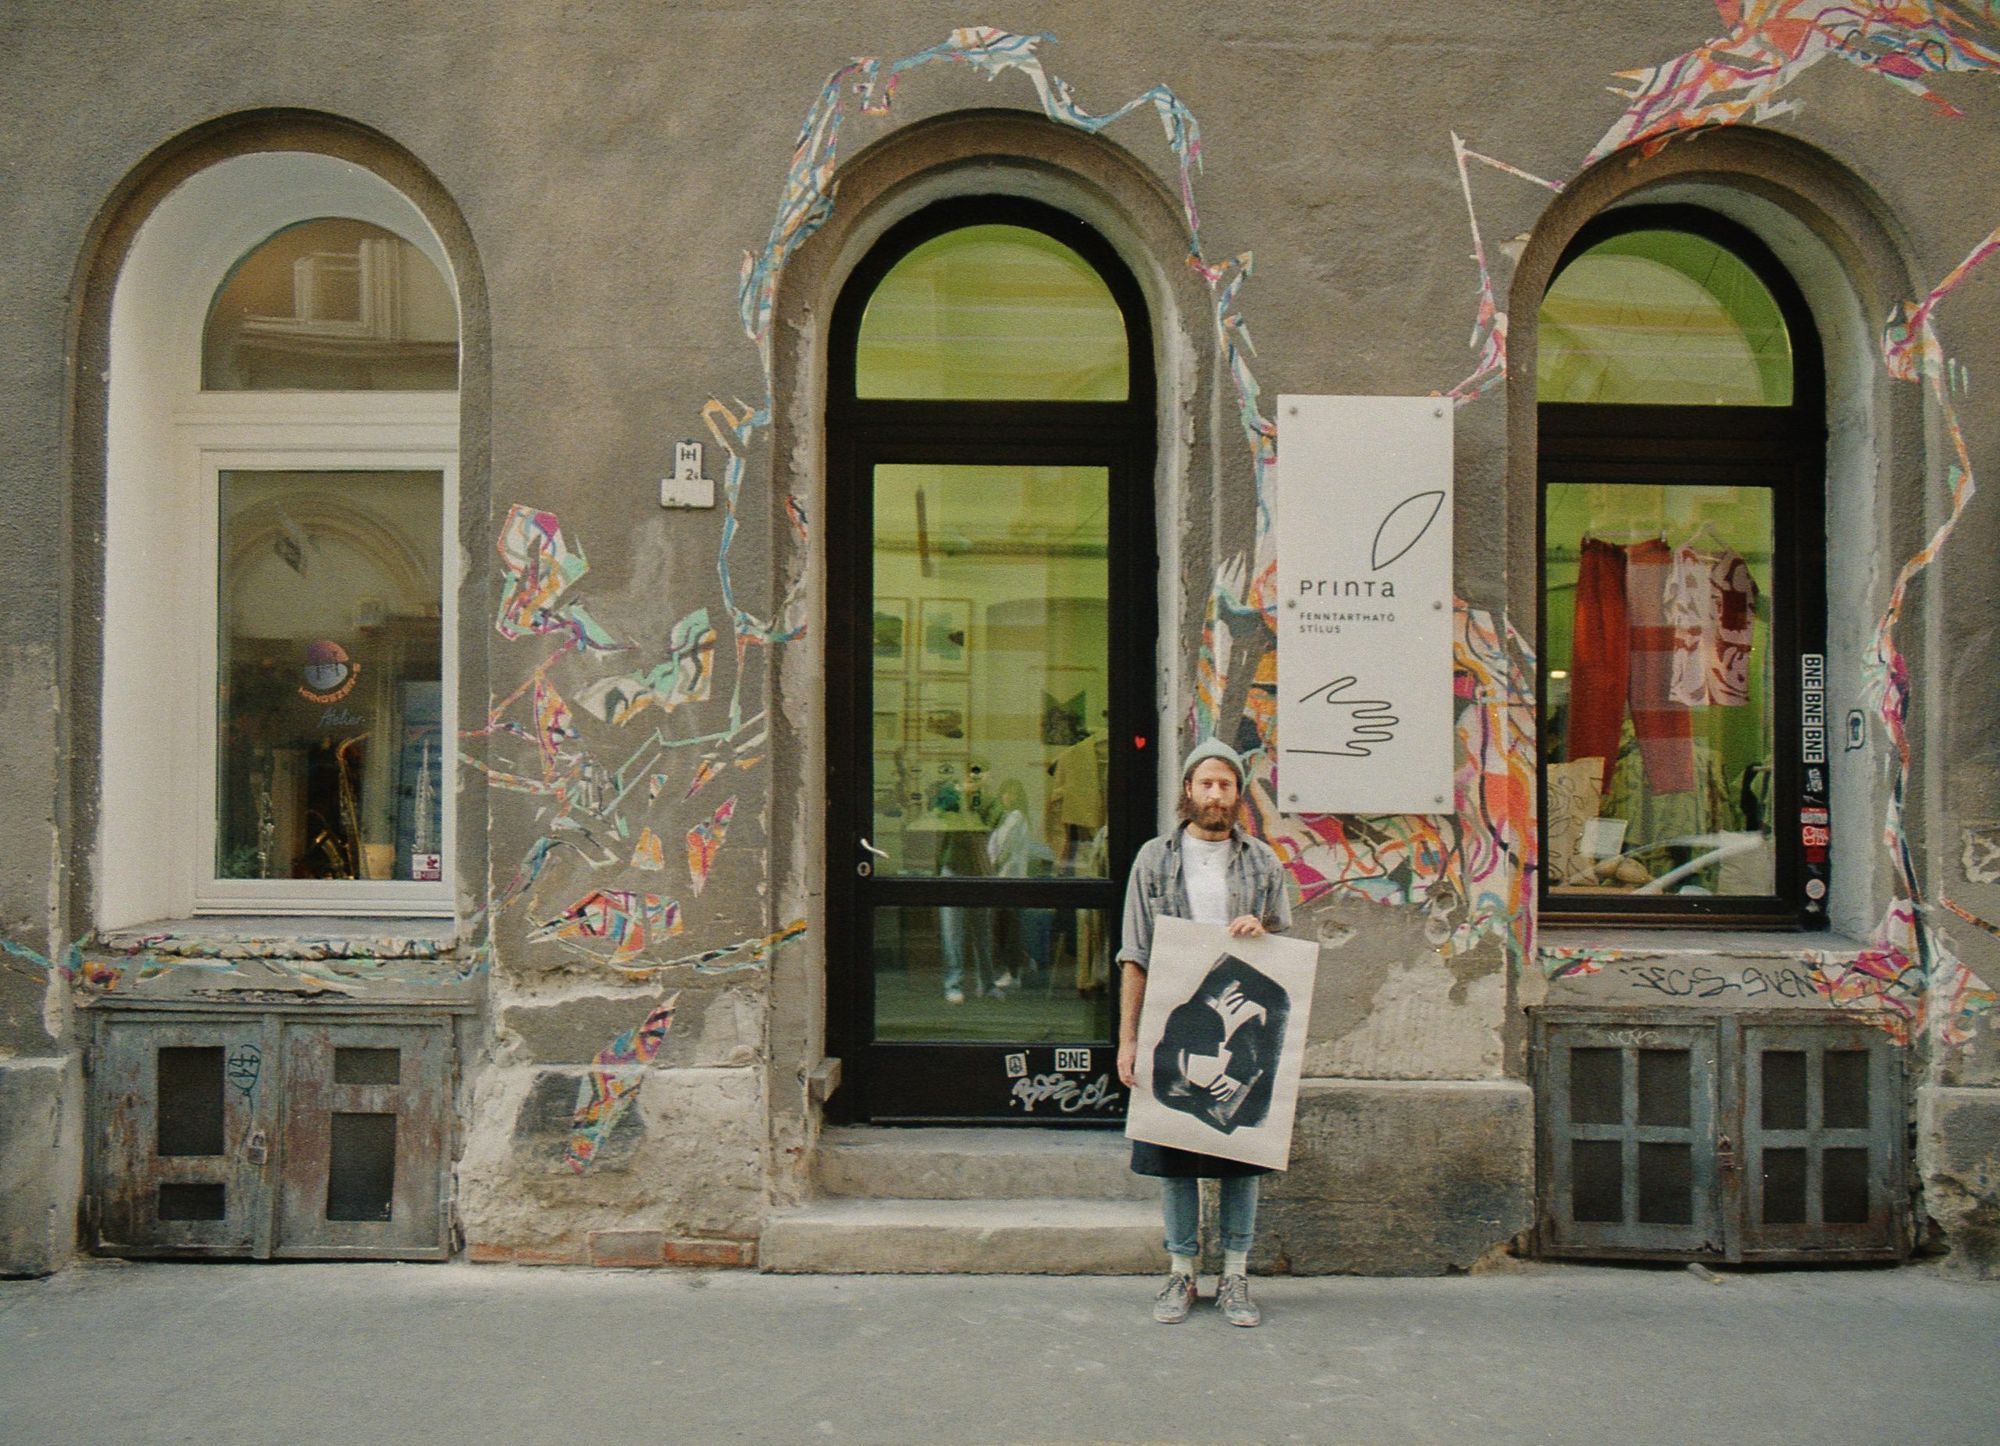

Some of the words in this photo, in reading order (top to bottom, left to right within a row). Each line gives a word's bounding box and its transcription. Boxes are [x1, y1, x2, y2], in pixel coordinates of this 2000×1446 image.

[1805, 656, 1821, 688] BNE
[1805, 692, 1821, 724] BNE
[1806, 729, 1822, 761] BNE
[1058, 1051, 1089, 1069] BNE
